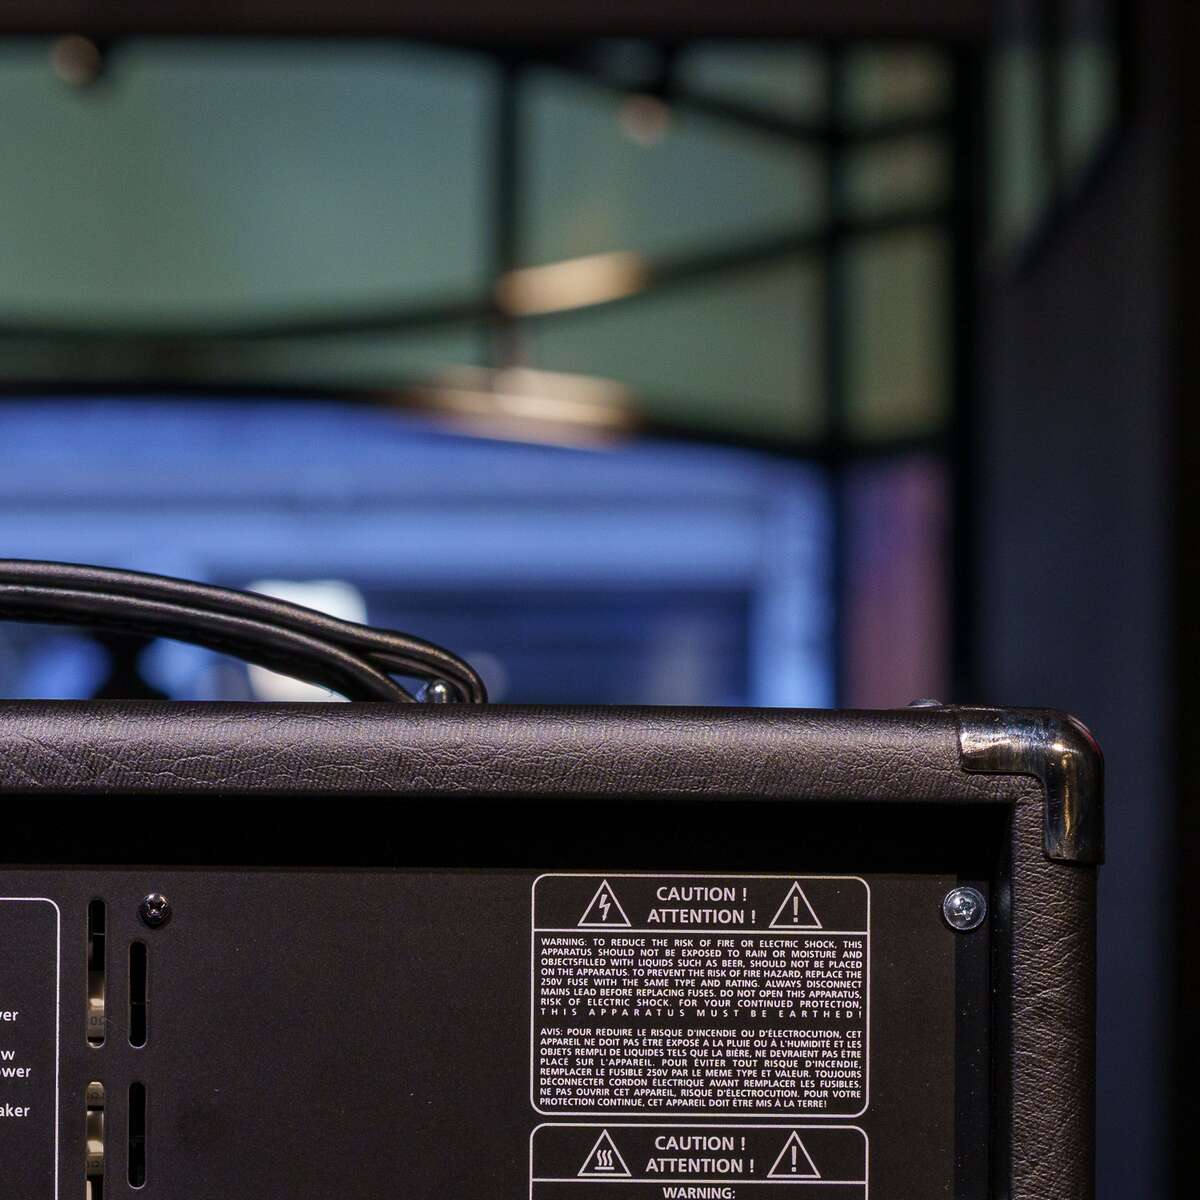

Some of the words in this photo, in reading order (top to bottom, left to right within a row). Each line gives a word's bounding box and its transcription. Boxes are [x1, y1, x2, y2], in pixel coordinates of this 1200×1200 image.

[656, 886, 735, 901] CAUTION
[647, 908, 744, 924] ATTENTION
[540, 997, 561, 1005] RISK
[568, 997, 580, 1006] OF
[587, 998, 630, 1006] ELECTRIC
[636, 998, 673, 1007] SHOCK.
[678, 998, 697, 1007] FOR
[704, 999, 730, 1007] YOUR
[737, 999, 793, 1008] CONTINUED
[799, 999, 862, 1009] PROTECTION,
[608, 1077, 647, 1086] CORDON
[709, 1078, 739, 1087] AVANT
[743, 1079, 795, 1087] REMPLACER
[800, 1079, 815, 1087] LES
[654, 1135, 734, 1150] CAUTION
[645, 1157, 742, 1173] ATTENTION
[662, 1186, 735, 1199] WARNING:
